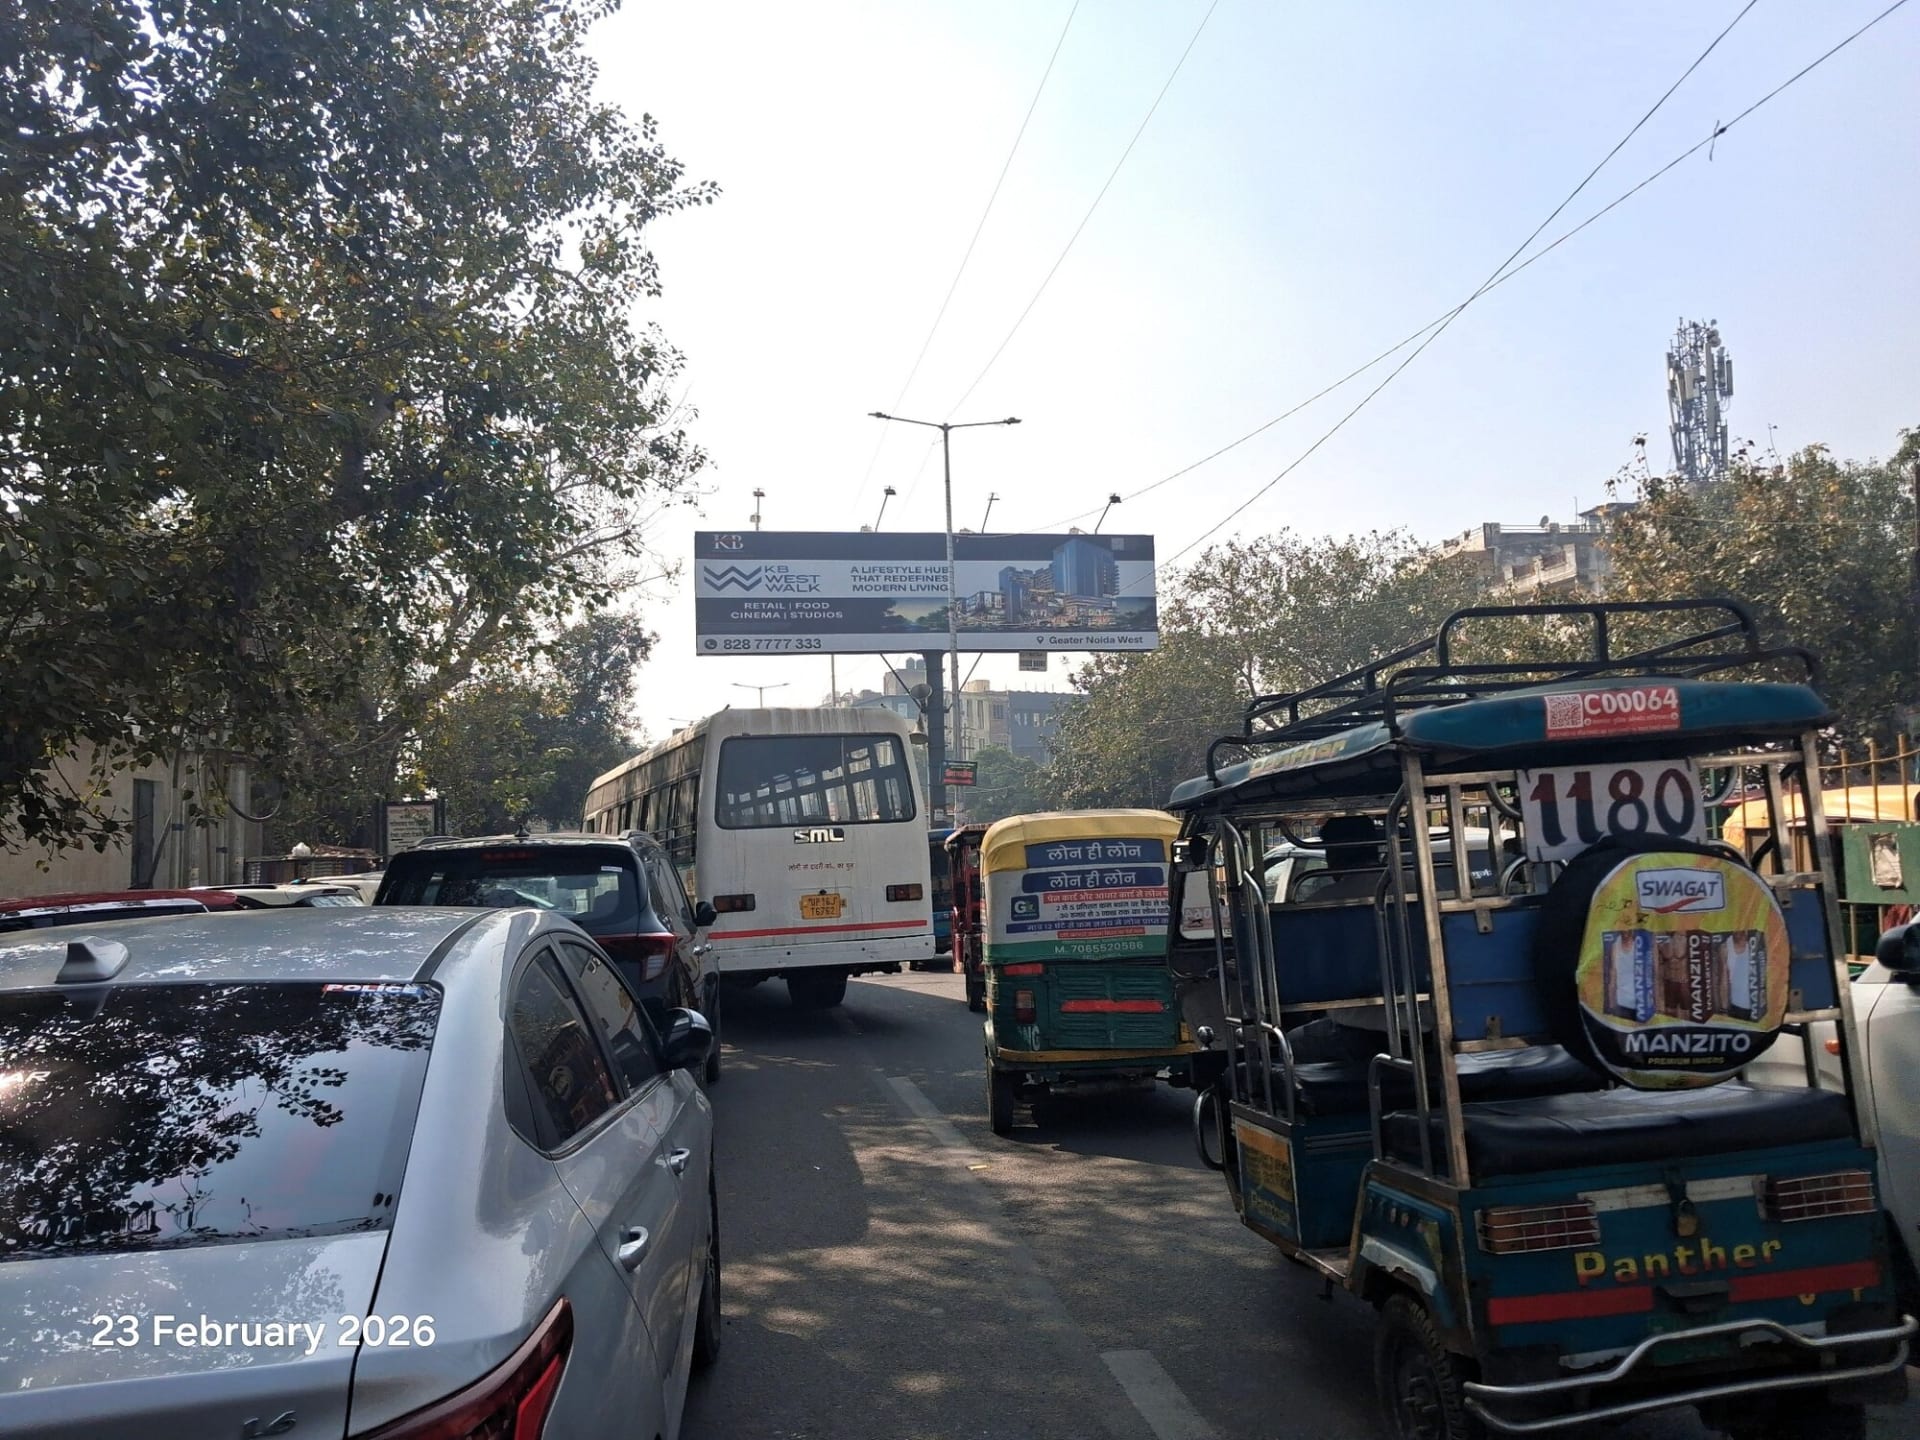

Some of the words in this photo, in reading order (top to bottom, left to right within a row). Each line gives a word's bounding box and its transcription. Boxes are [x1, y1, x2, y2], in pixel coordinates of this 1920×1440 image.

[764, 565, 790, 574] KB
[850, 566, 859, 574] A
[862, 566, 922, 574] LIFESTYLE
[924, 566, 948, 574] HUB
[765, 574, 820, 584] WEST
[852, 574, 882, 583] THAT
[884, 574, 948, 583] REDEFINES
[765, 584, 821, 593] WALK
[852, 584, 907, 592] MODERN
[909, 584, 948, 592] LIVING
[744, 602, 785, 610] RETAIL
[795, 602, 830, 610] FOOD
[730, 611, 781, 620] CINEMA
[790, 611, 843, 619] STUDIOS
[723, 638, 751, 650] 828
[755, 638, 792, 650] 7777
[795, 638, 822, 650] 333
[1048, 636, 1084, 645] Geater
[1086, 635, 1116, 644] Noida
[1118, 635, 1144, 644] West
[1584, 687, 1679, 715] C00064
[1529, 768, 1696, 847] 1180
[794, 828, 844, 843] SML
[1046, 844, 1082, 861] लोन
[1086, 842, 1102, 860] ही
[1106, 841, 1141, 858] लोन
[1048, 872, 1082, 889] लोन
[1084, 870, 1100, 888] ही
[1104, 870, 1136, 886] लोन
[1641, 880, 1719, 897] SWAGAT
[1689, 934, 1704, 1020] MANZITO
[326, 984, 419, 994] POLICE
[1625, 1033, 1751, 1053] MANZITO
[1574, 1237, 1782, 1286] Panther
